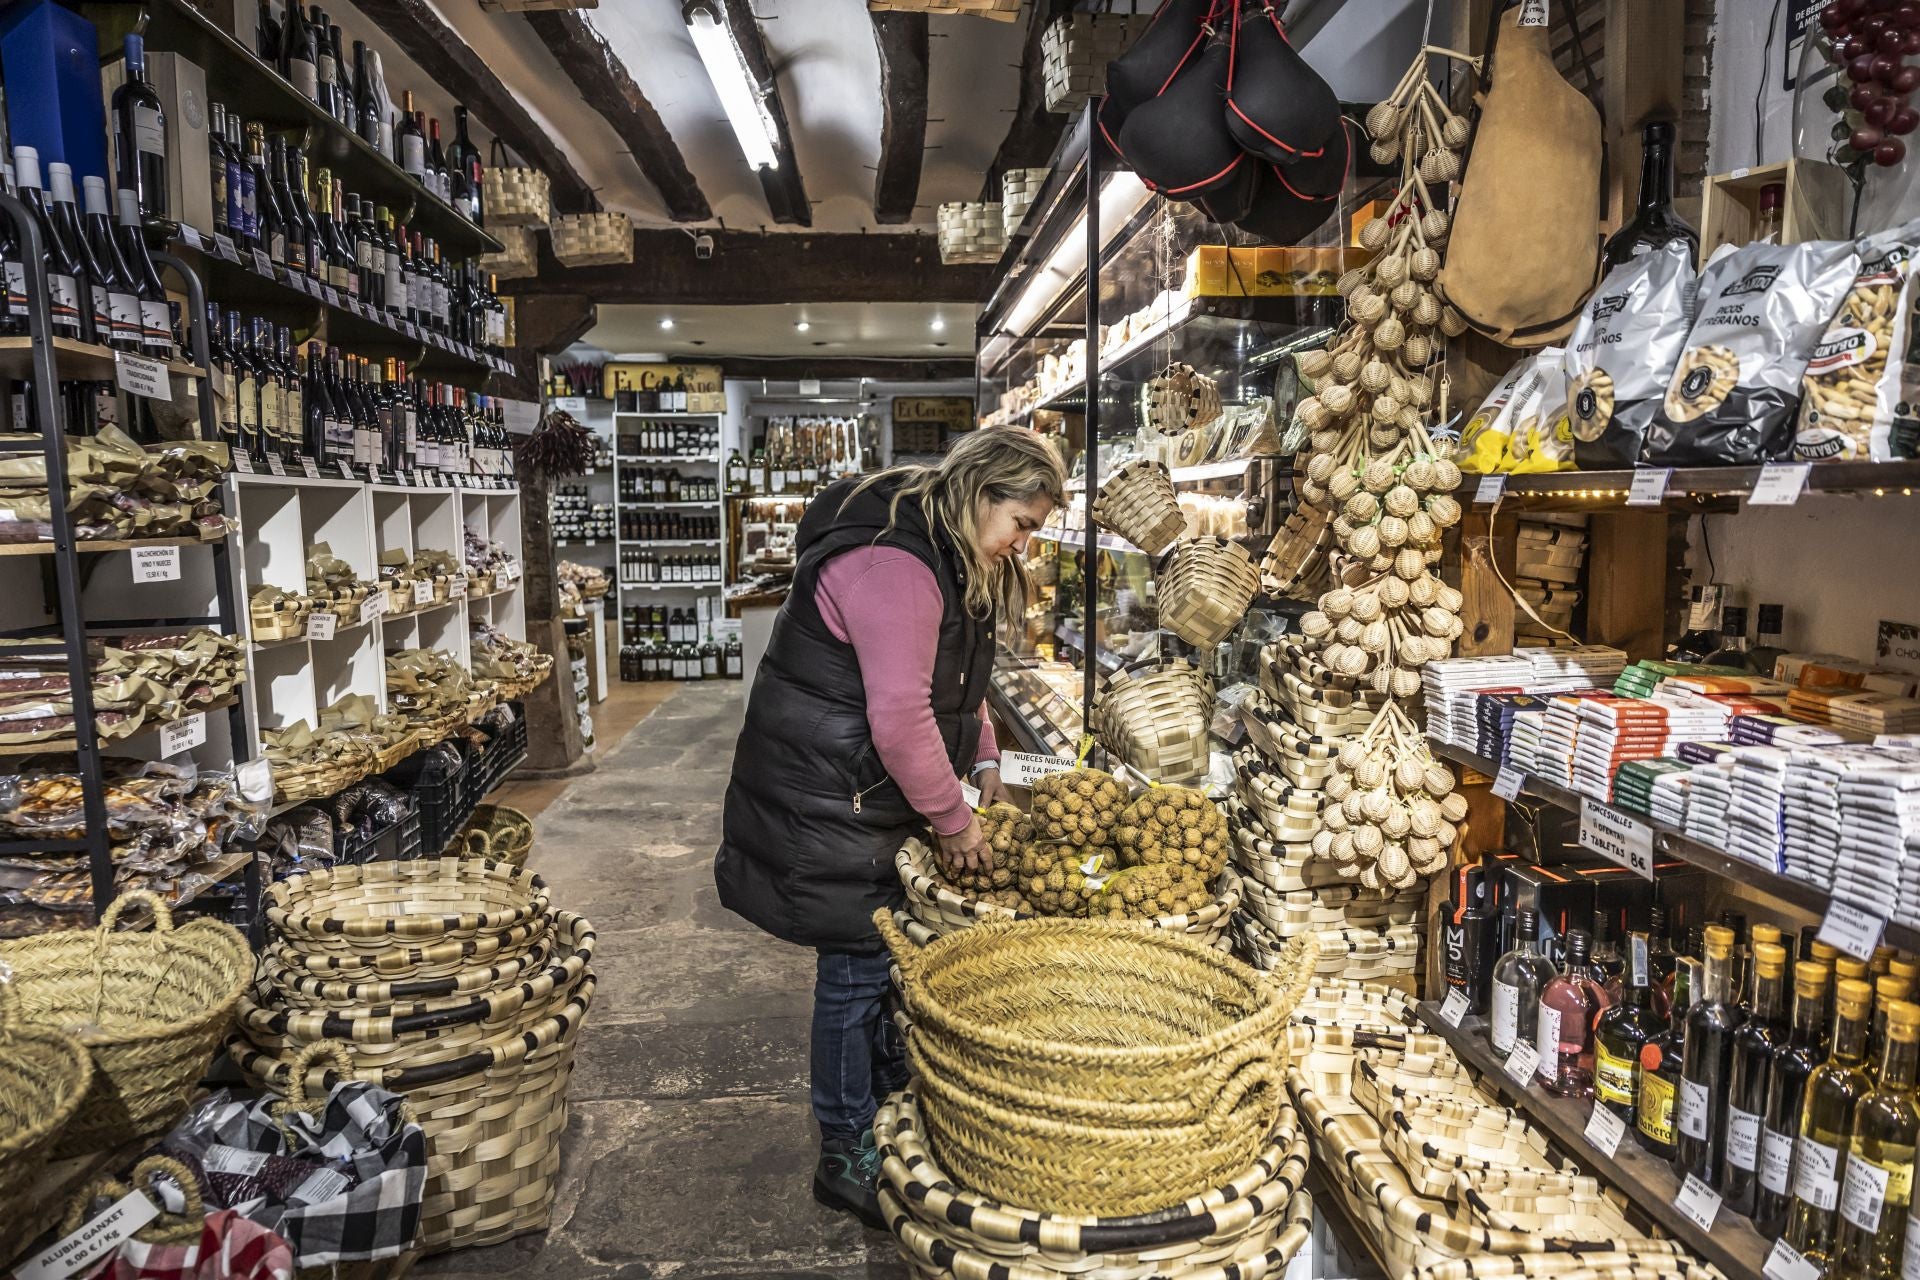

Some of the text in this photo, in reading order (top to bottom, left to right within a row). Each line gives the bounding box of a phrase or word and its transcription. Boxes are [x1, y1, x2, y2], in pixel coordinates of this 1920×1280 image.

[1815, 338, 1859, 358] OBAND
[1896, 648, 1920, 660] CHO
[1014, 753, 1075, 767] NUECES NUEVAS
[1588, 801, 1632, 829] RONCESVALLES
[1582, 829, 1587, 841] 3
[1591, 835, 1625, 857] TABLETAS
[1446, 925, 1464, 948] M
[1449, 943, 1462, 961] 5
[42, 1208, 124, 1267] ALUBIA GANXET
[65, 1249, 88, 1267] 8,00
[89, 1243, 98, 1252] €
[103, 1229, 121, 1243] Kg
